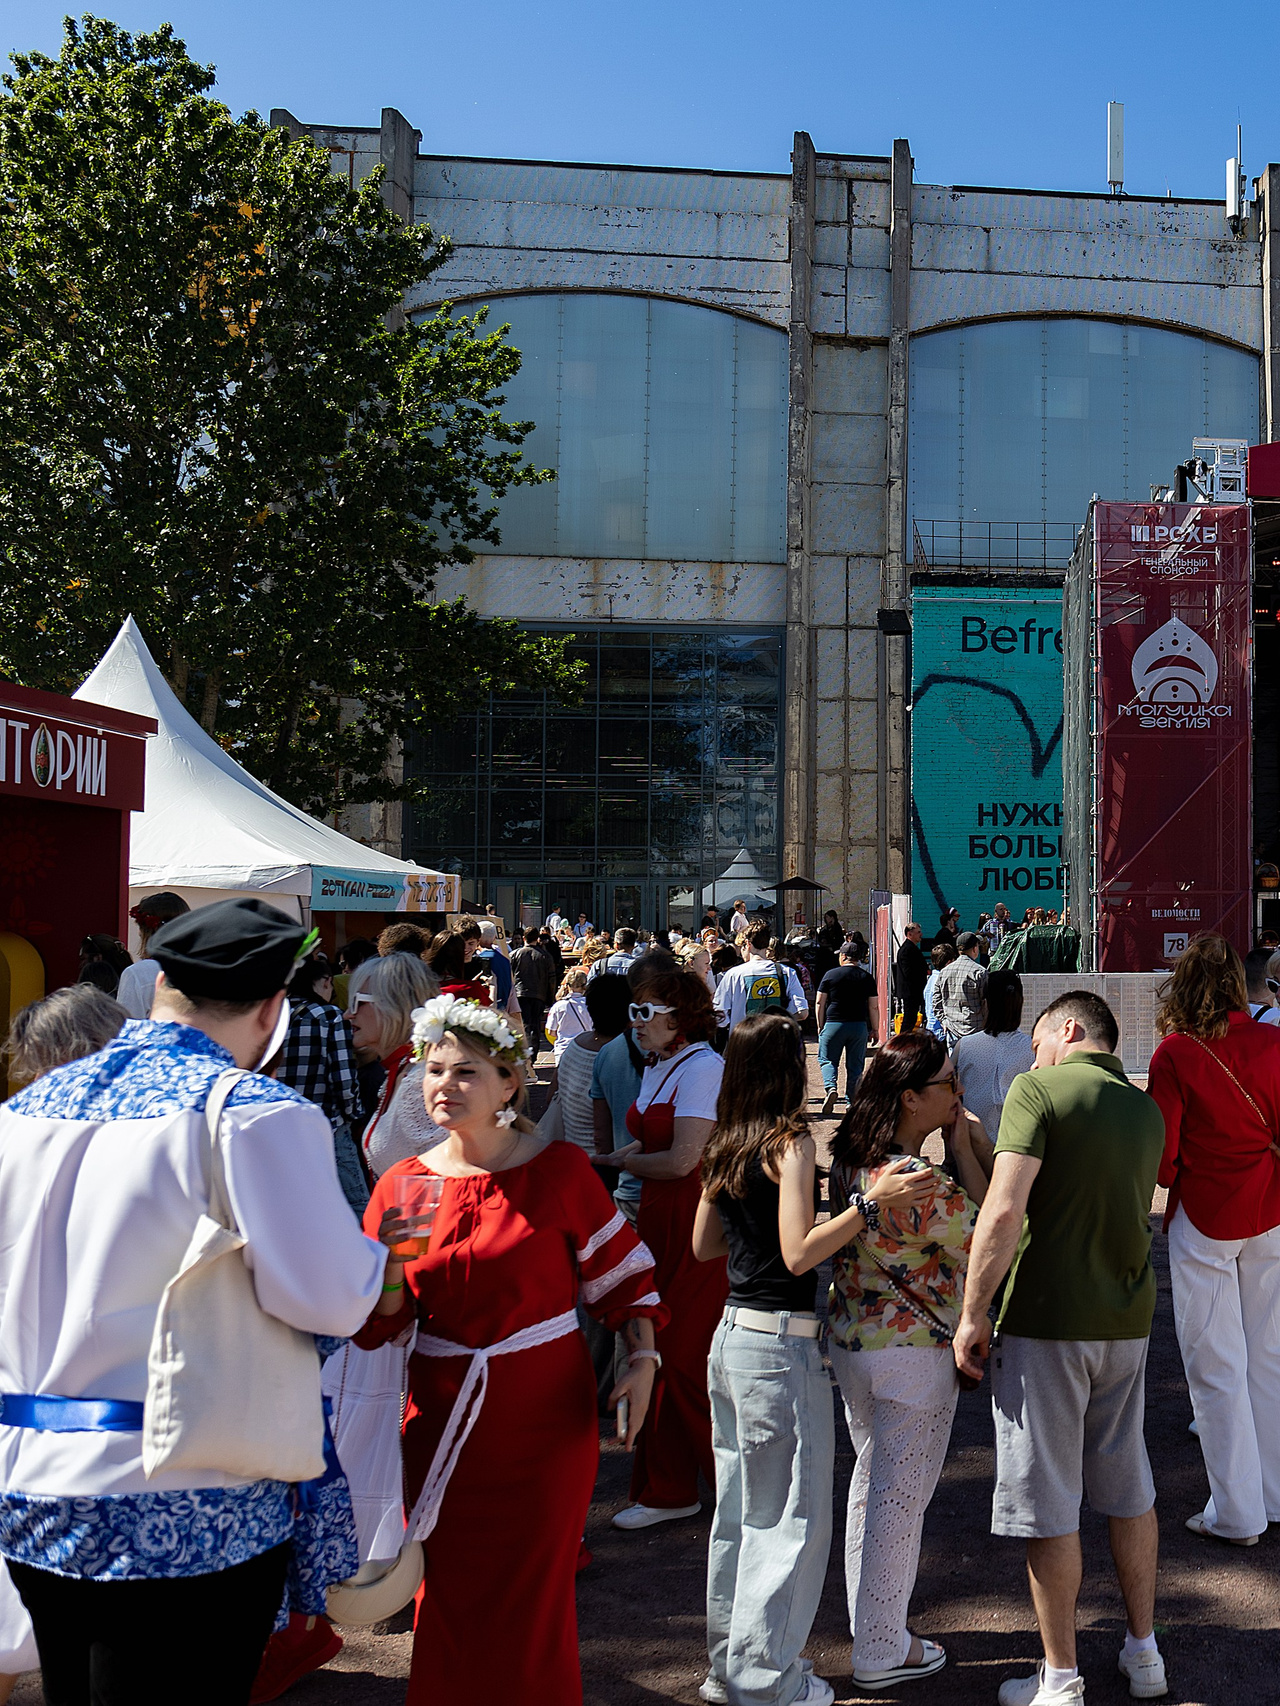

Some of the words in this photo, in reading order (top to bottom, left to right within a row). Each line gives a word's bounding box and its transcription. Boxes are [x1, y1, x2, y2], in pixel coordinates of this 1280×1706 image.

[1155, 525, 1218, 544] РСХБ
[1141, 557, 1208, 567] ГЕНЕРАЛЬНЫЙ
[1150, 566, 1200, 575] СПОНСОР
[1151, 909, 1200, 918] ВЕДОМОСТИ
[1167, 938, 1185, 953] 78
